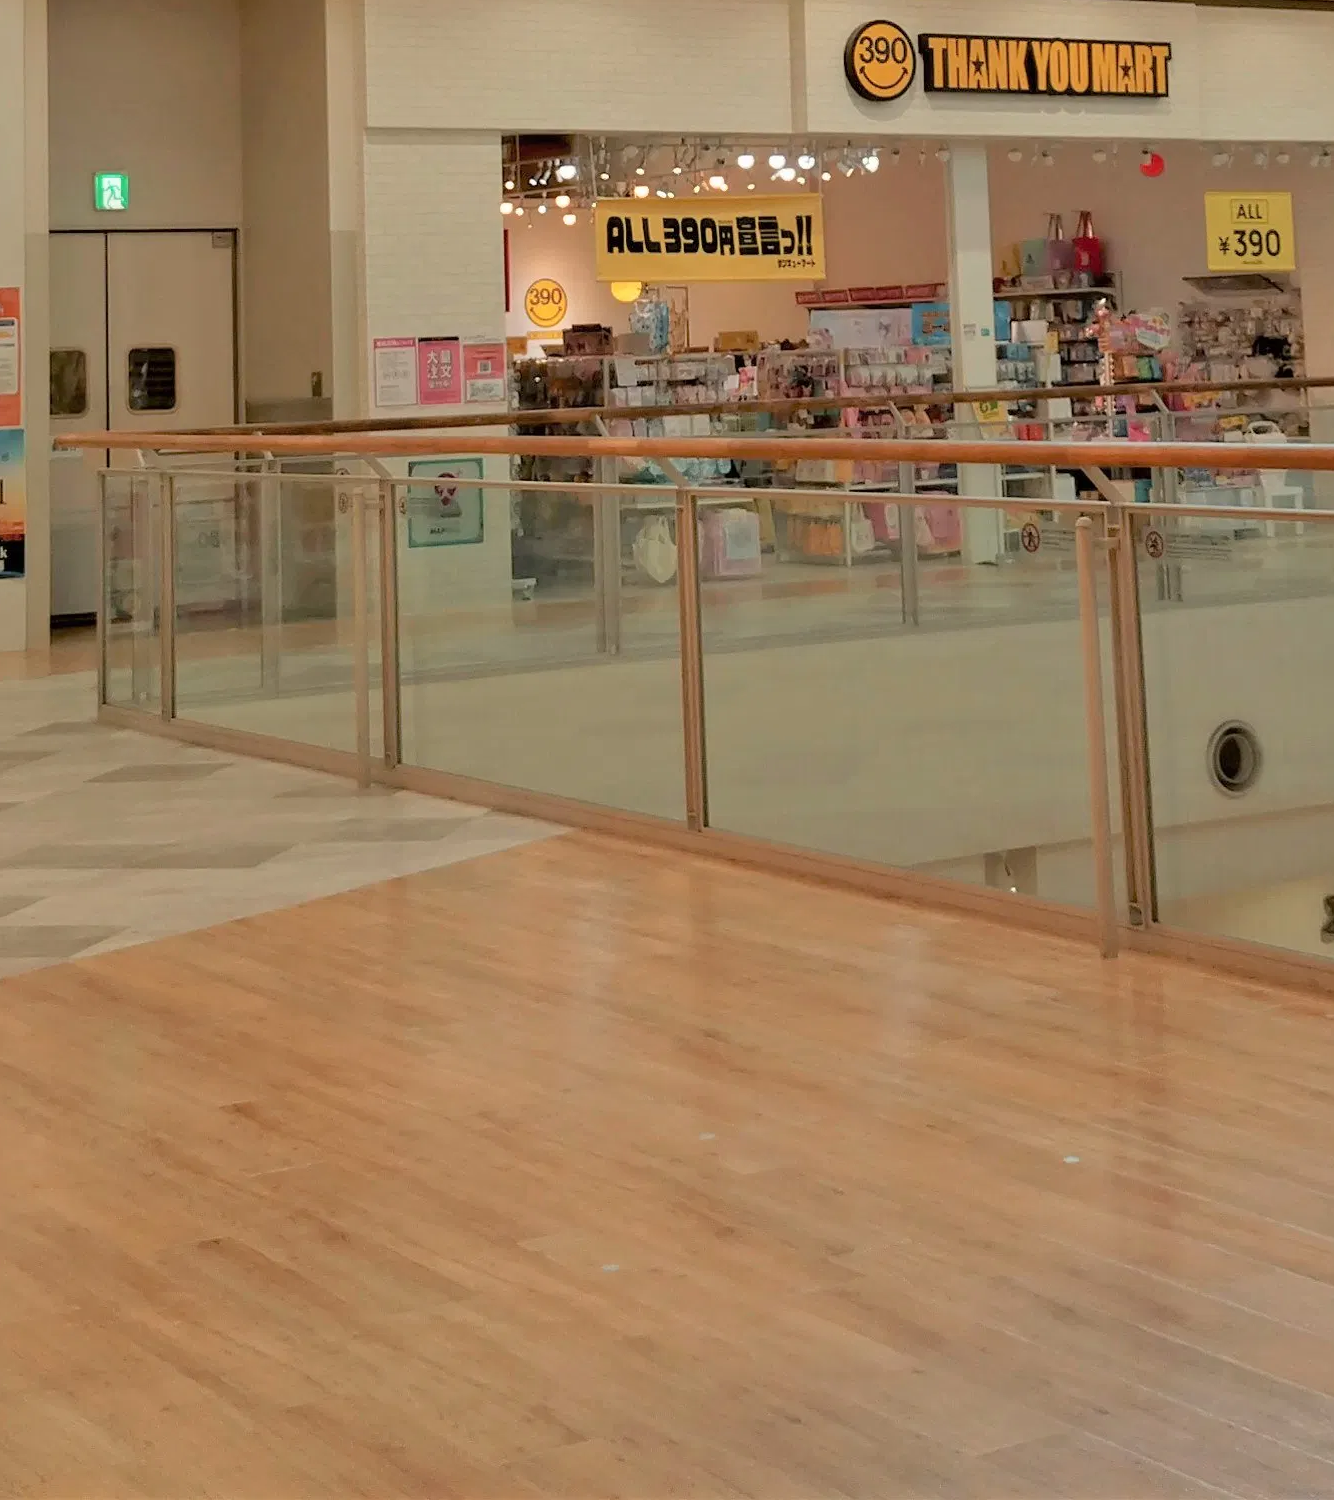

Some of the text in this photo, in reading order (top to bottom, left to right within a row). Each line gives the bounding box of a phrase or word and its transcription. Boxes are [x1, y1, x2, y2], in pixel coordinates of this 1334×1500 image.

[858, 36, 908, 65] 390
[927, 36, 1169, 94] THANK YOU MART
[1236, 203, 1263, 220] ALL
[1218, 228, 1281, 257] ¥390
[529, 287, 562, 305] 390
